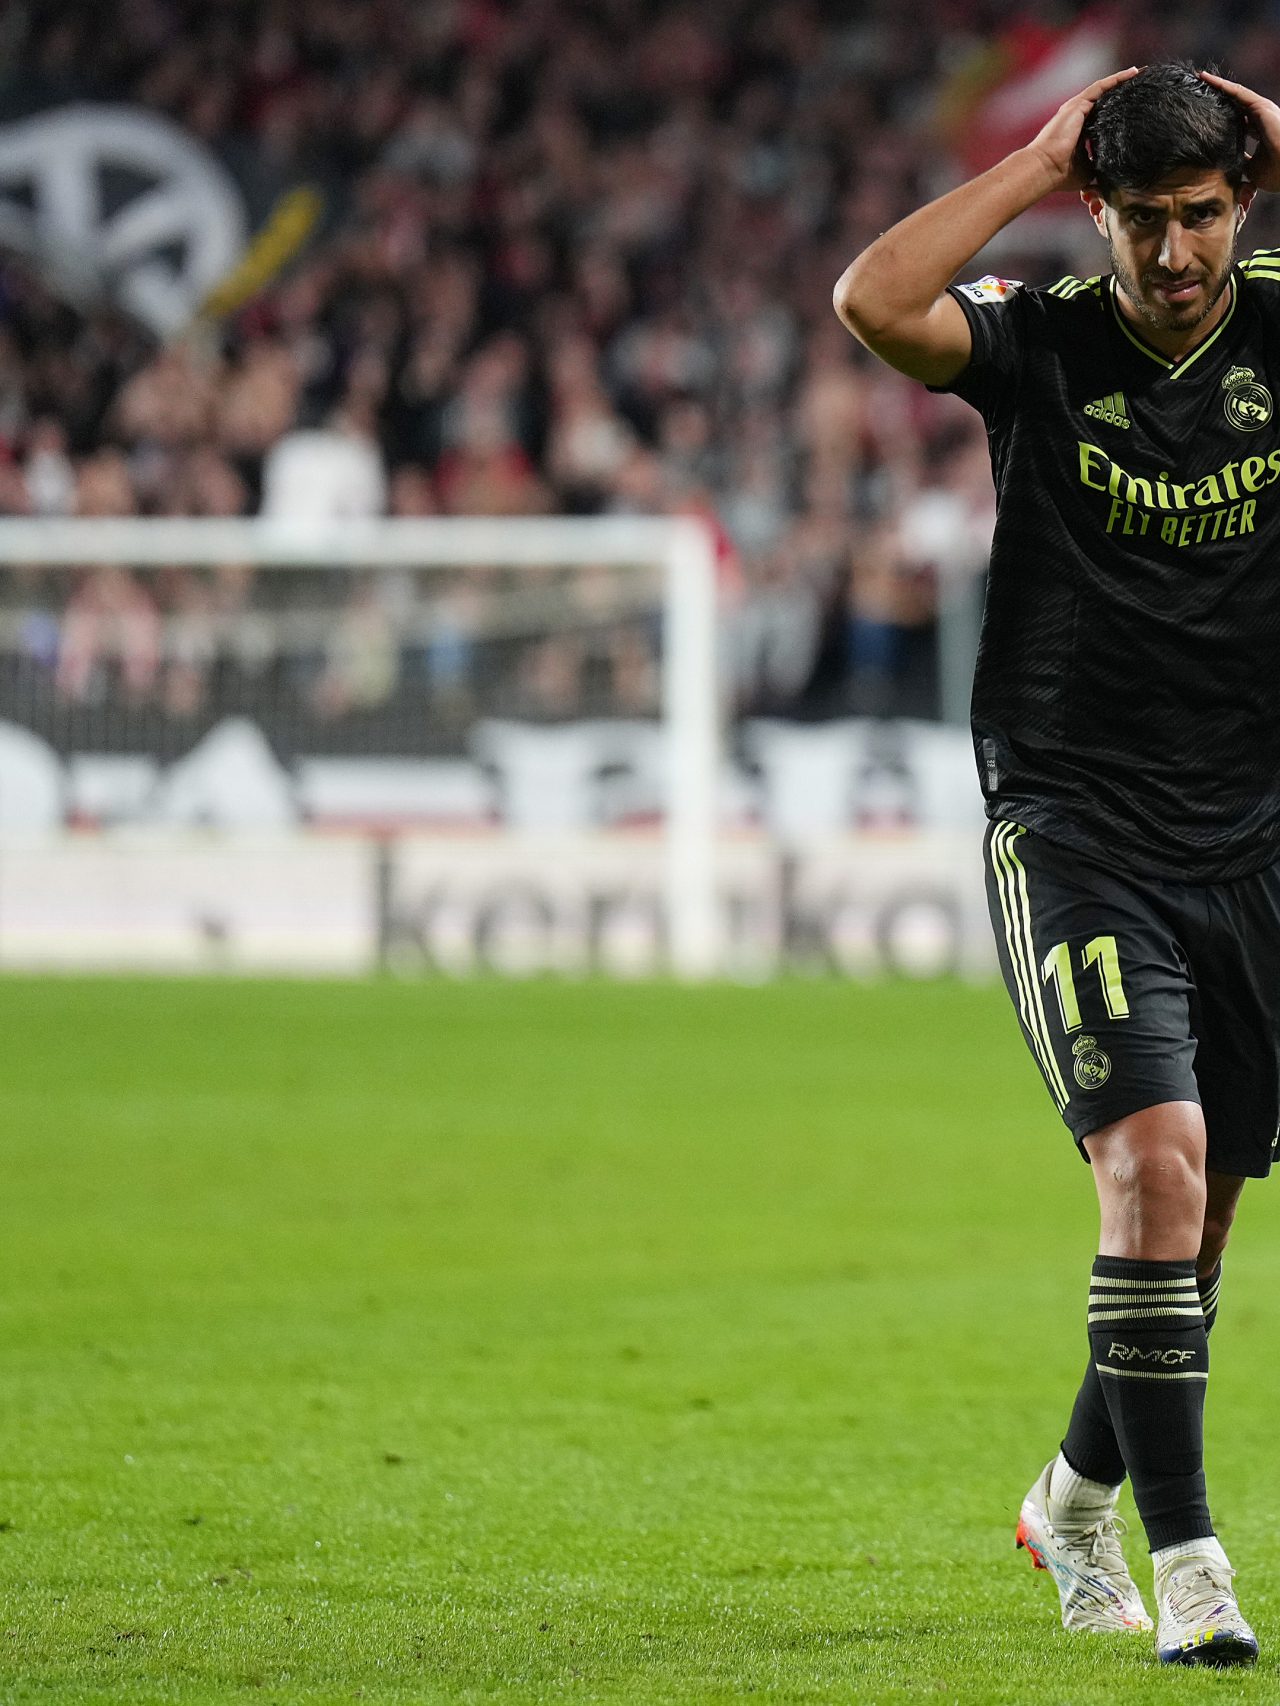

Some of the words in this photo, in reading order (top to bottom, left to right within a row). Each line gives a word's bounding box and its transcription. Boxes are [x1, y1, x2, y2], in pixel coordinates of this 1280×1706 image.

[1083, 404, 1131, 430] adidas
[1105, 498, 1150, 536] FLY
[1160, 499, 1257, 548] BETTER
[1041, 935, 1130, 1034] 11
[1107, 1341, 1197, 1365] RMCF
